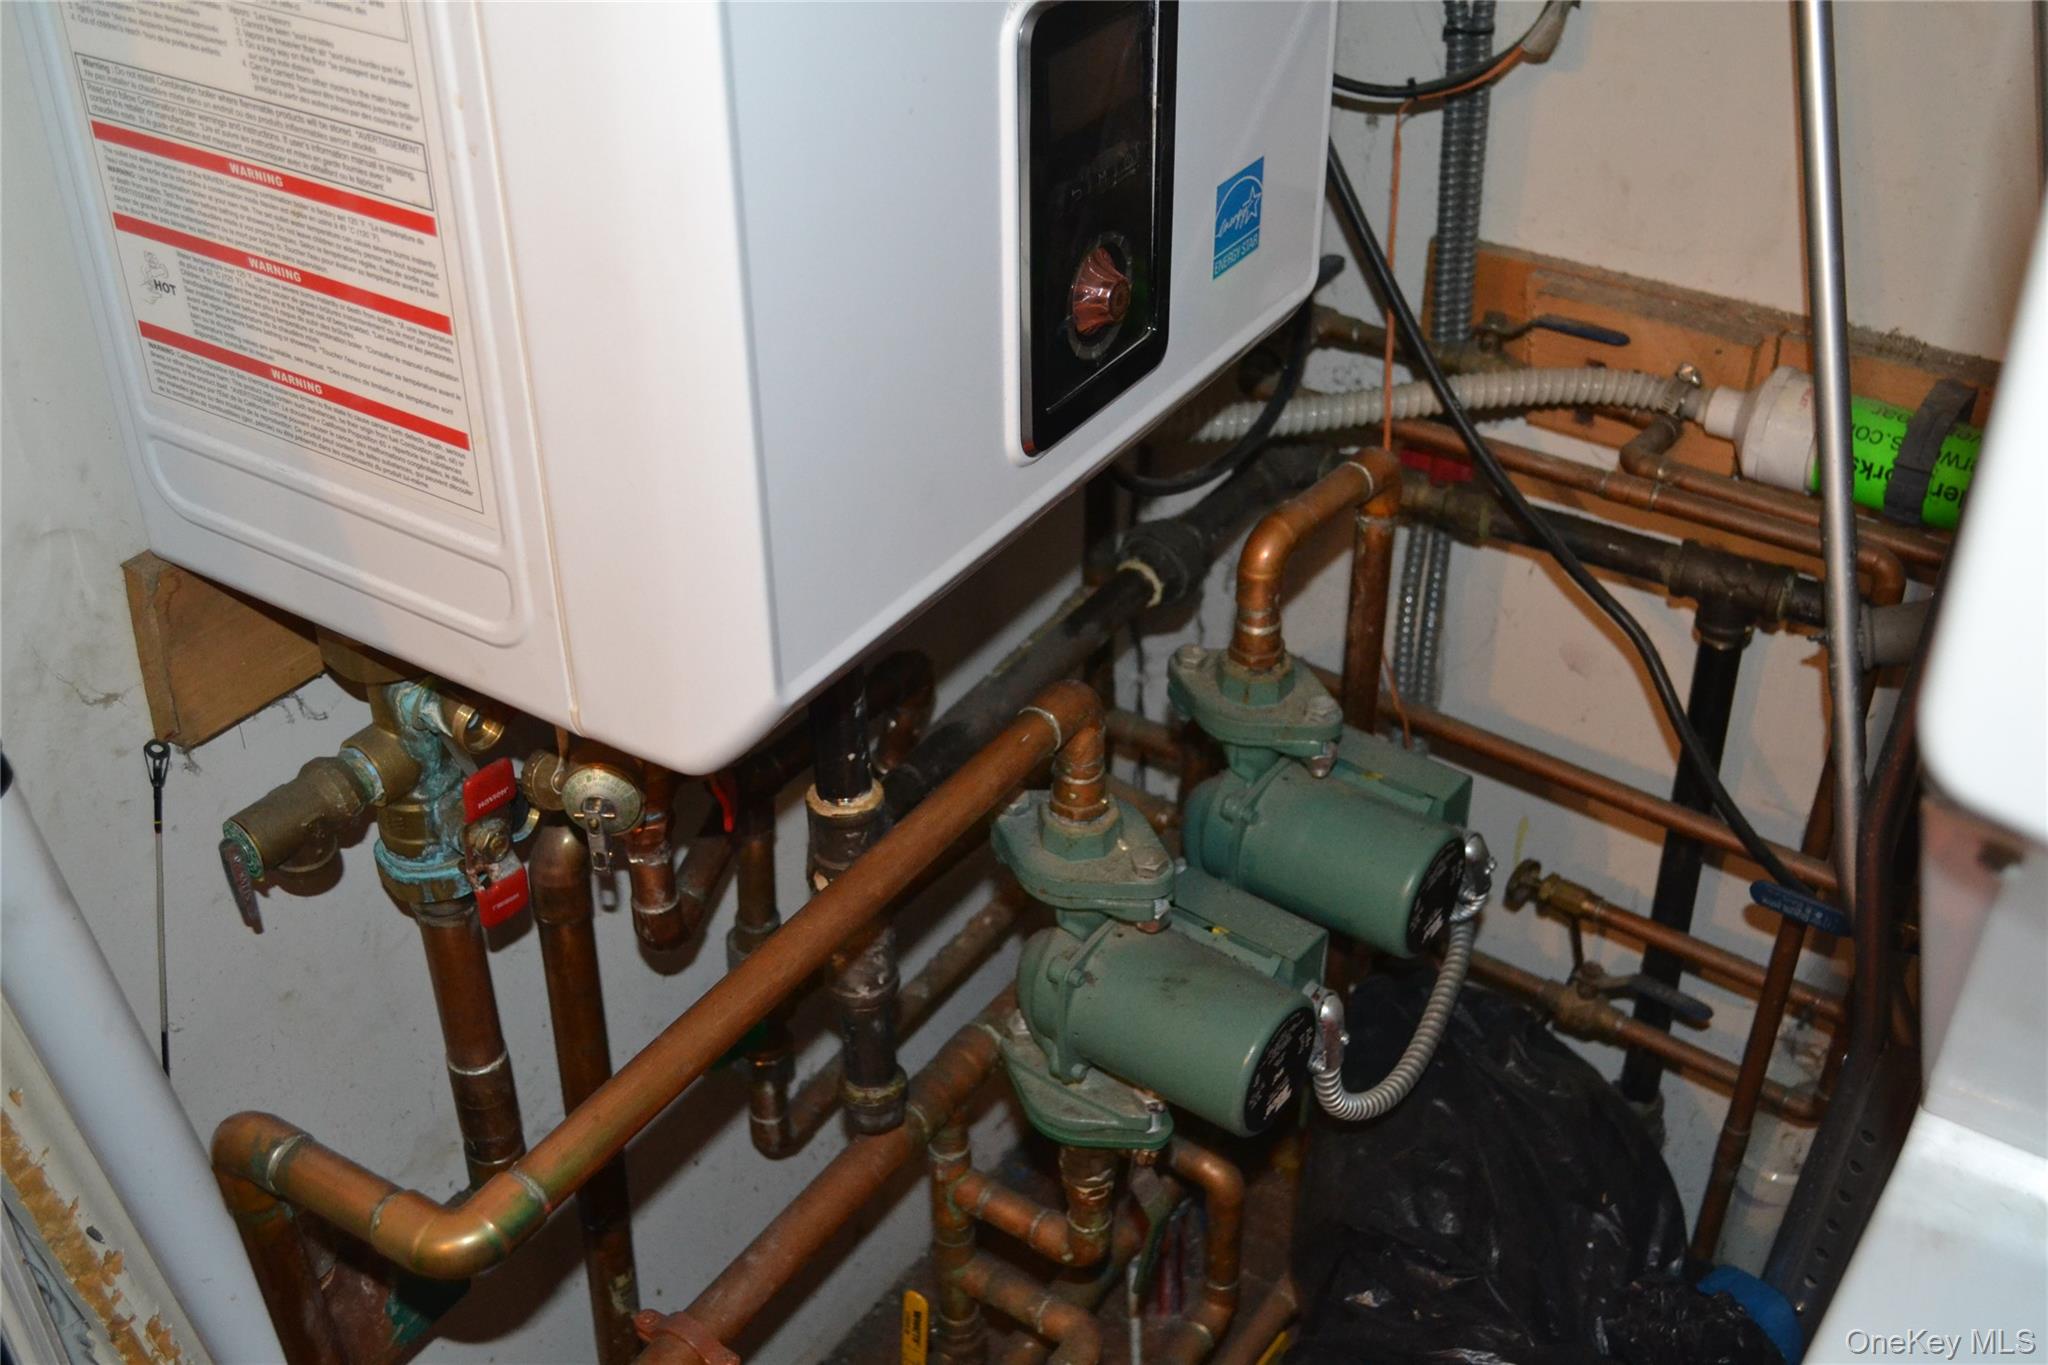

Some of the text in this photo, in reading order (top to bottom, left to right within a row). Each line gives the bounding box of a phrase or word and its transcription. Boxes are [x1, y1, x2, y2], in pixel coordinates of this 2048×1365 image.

[229, 162, 284, 188] WARNING
[1214, 233, 1258, 275] ENERGY STAR
[248, 257, 302, 283] WARNING
[153, 279, 176, 296] HOT
[271, 368, 324, 395] WARNING
